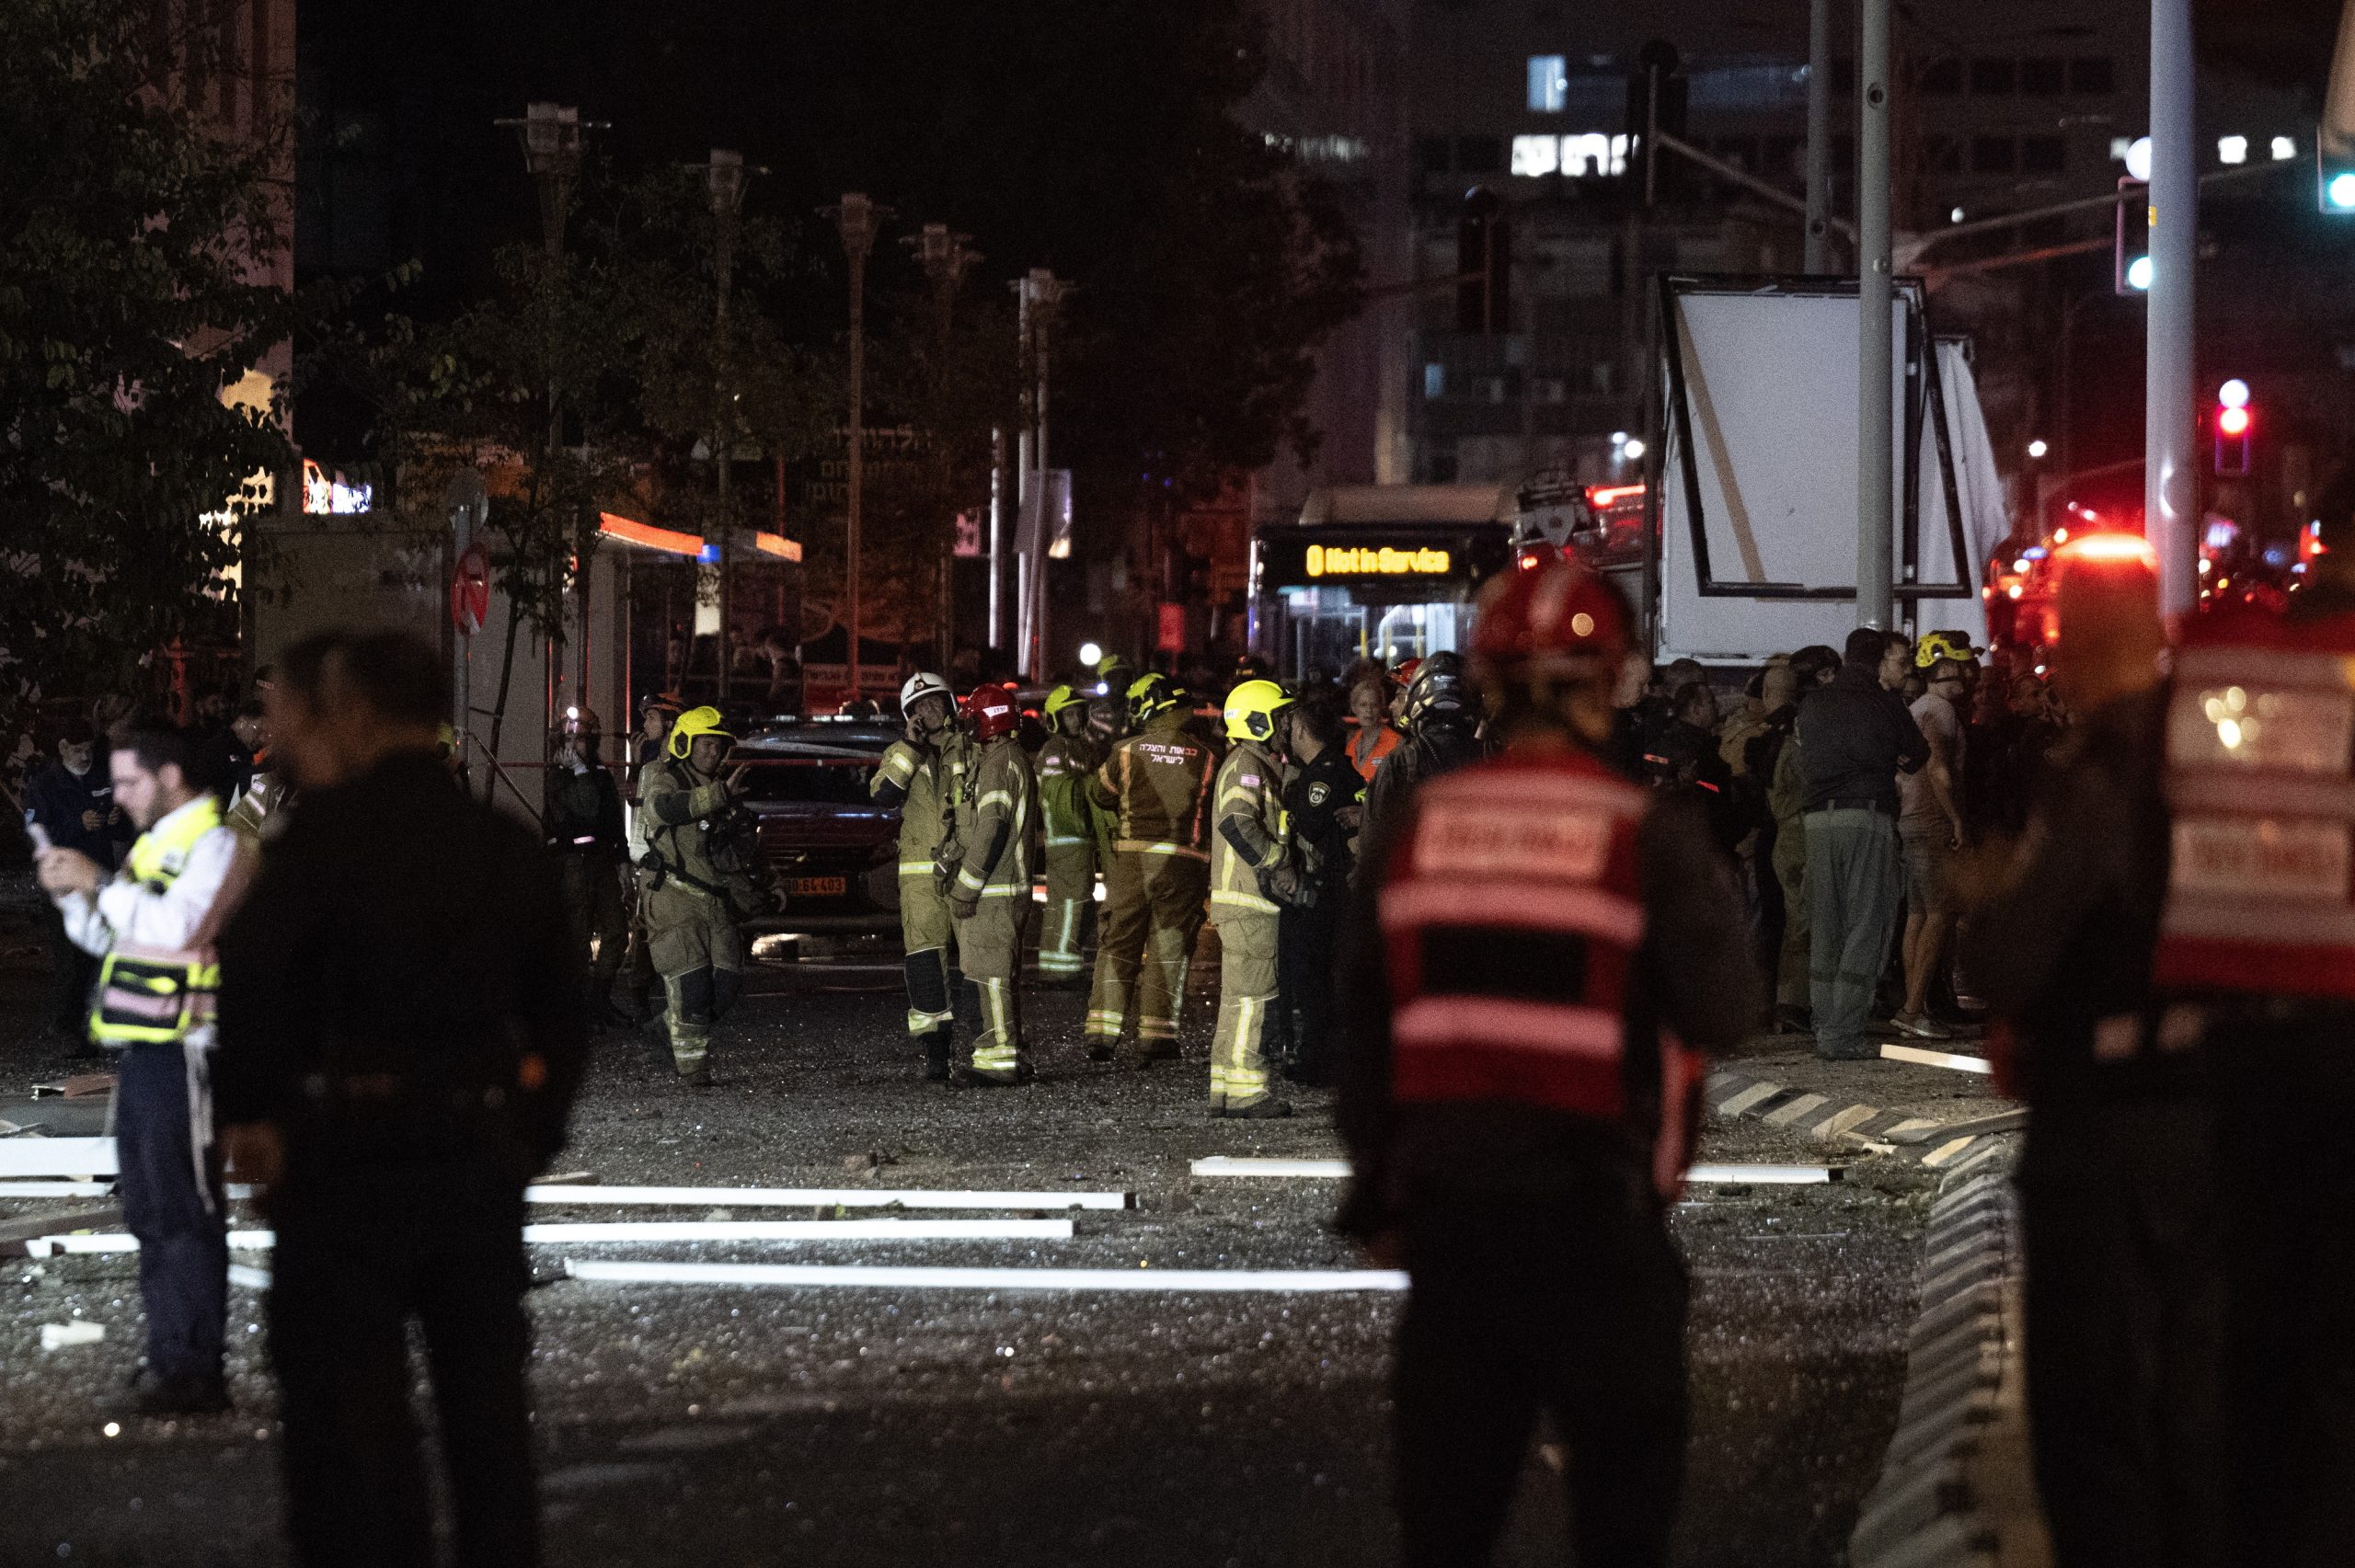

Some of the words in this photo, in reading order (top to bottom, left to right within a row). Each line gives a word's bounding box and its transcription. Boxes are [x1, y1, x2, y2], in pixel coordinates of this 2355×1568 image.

[1326, 547, 1360, 573] Not
[1360, 547, 1378, 573] in
[1378, 547, 1450, 574] Service
[1139, 743, 1166, 753] והצלה
[1169, 746, 1198, 756] כבאות
[1151, 753, 1184, 764] לישראל
